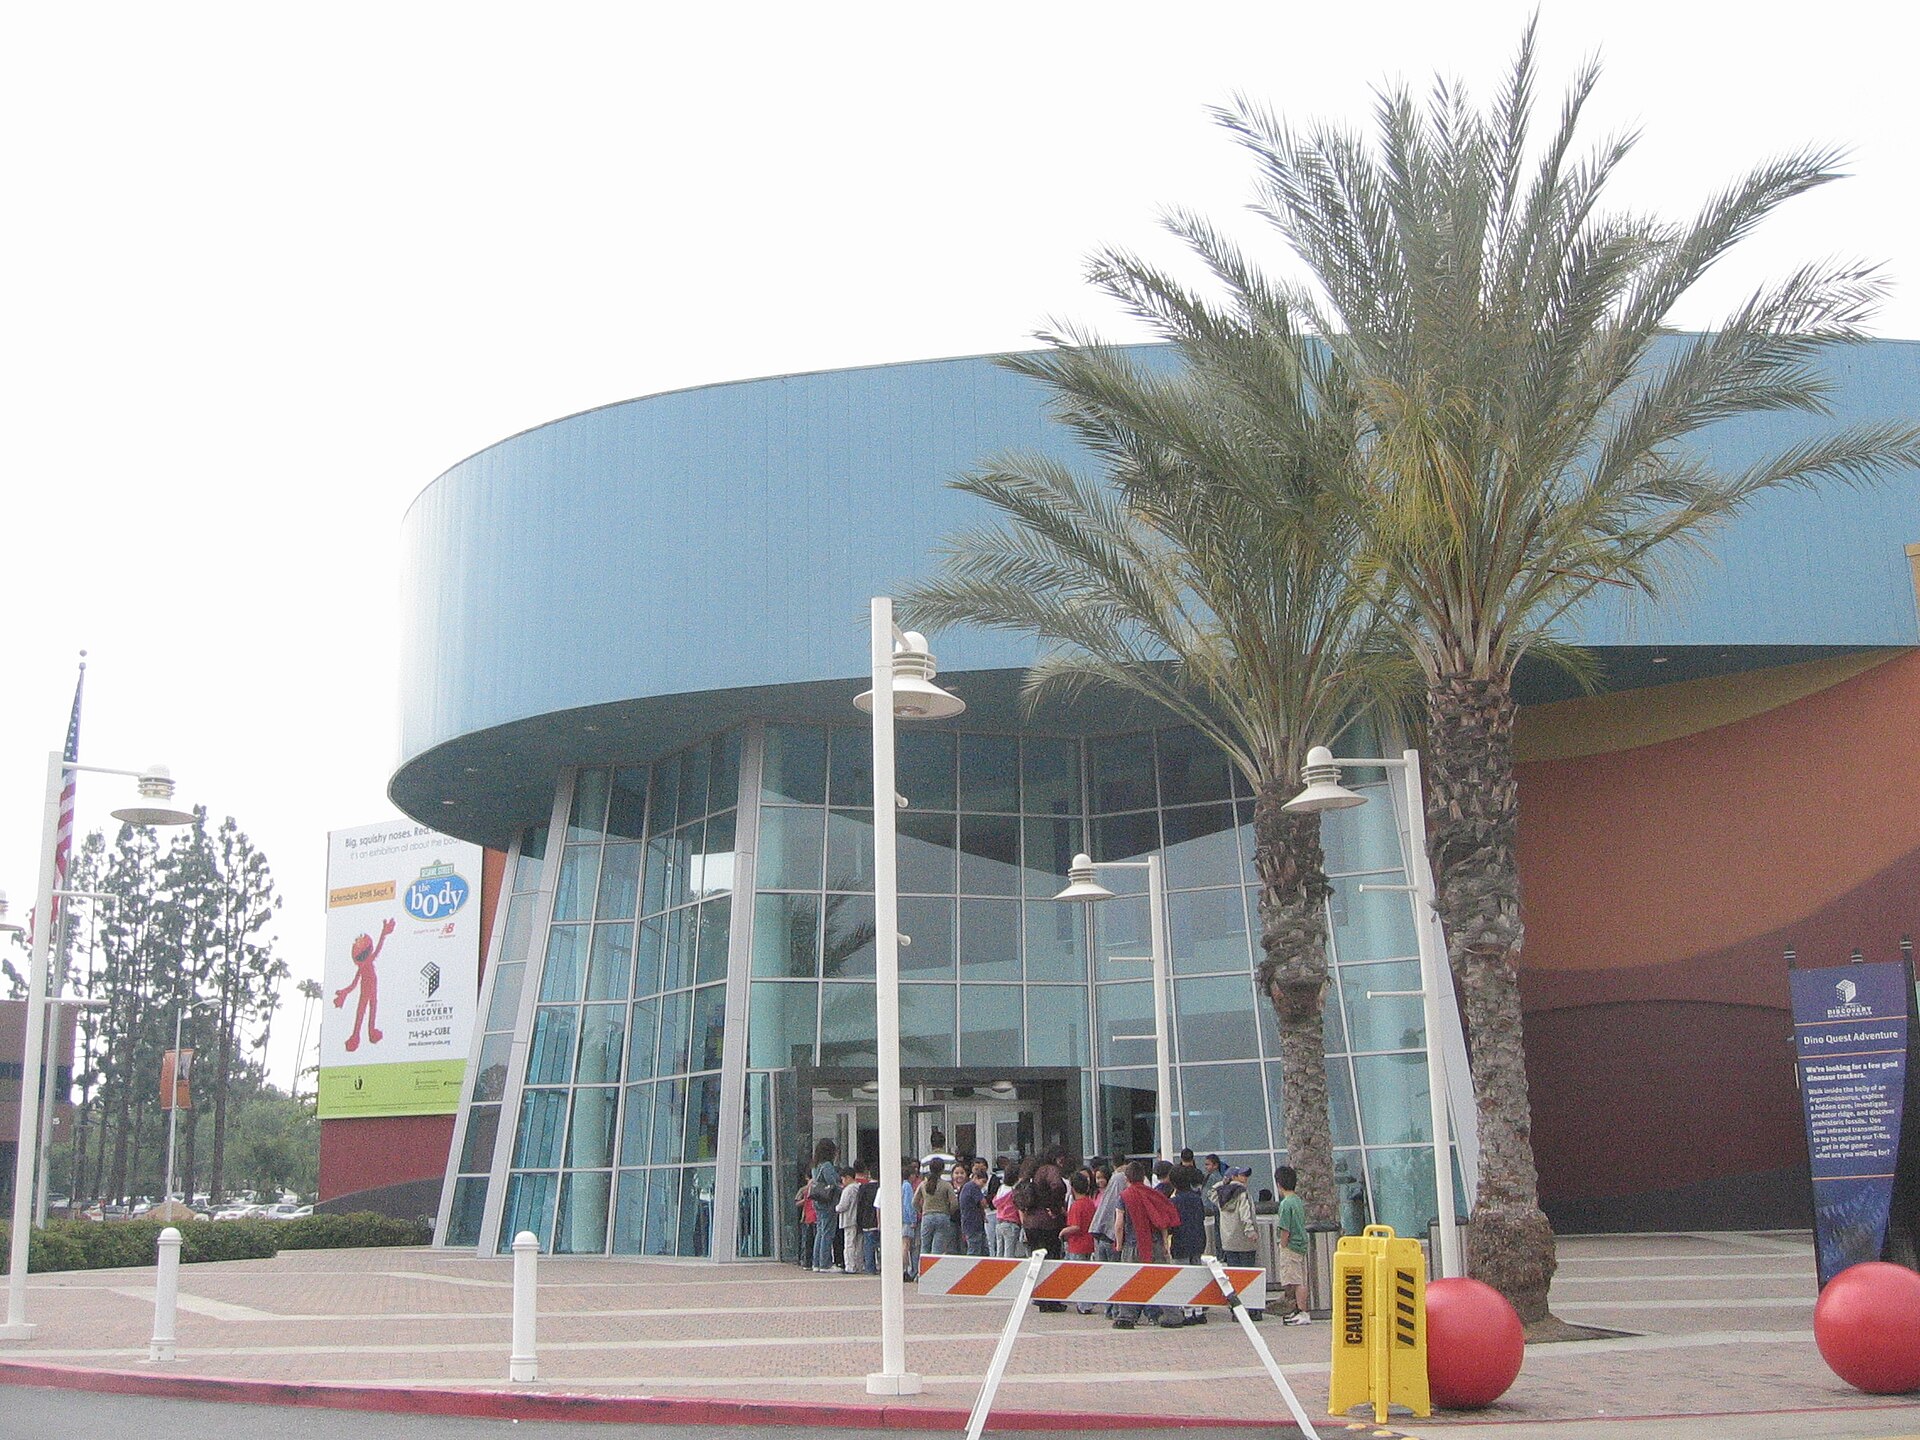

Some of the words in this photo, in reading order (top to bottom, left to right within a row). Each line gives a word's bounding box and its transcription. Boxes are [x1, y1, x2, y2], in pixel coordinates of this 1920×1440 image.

[360, 834, 387, 844] squishy
[419, 883, 430, 892] the
[330, 892, 358, 902] Extended
[411, 882, 464, 916] body
[407, 1006, 453, 1017] DISCOVERY
[1827, 1006, 1872, 1015] DISCOVERY
[1804, 1036, 1824, 1044] Dino
[1826, 1034, 1852, 1044] Quest
[1854, 1031, 1898, 1041] Adventure
[1882, 1060, 1898, 1070] good
[1345, 1275, 1362, 1344] CAUTION
